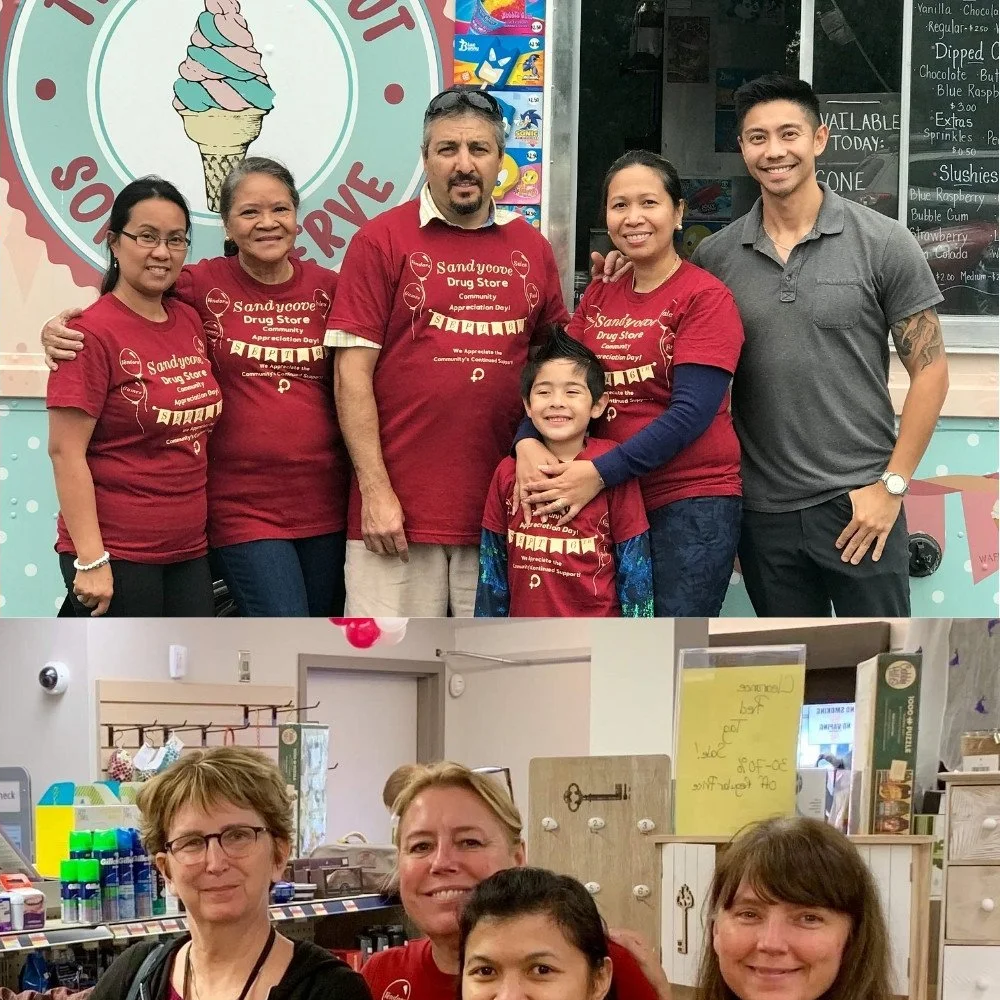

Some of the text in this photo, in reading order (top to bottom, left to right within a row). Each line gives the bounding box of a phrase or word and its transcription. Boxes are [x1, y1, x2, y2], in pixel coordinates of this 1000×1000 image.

[918, 3, 952, 14] Vanilla
[935, 40, 984, 69] Dipped
[920, 64, 967, 80] Chocolate
[937, 84, 962, 96] Blue
[820, 112, 900, 132] VAILABLE
[936, 112, 973, 128] Extras
[924, 128, 972, 144] Sprinkles
[831, 135, 885, 151] TODAY:
[940, 164, 999, 183] Slushies
[910, 187, 985, 212] Blue Raspberry
[911, 208, 969, 222] Bubble Gum
[437, 259, 513, 276] Sandycove
[447, 277, 508, 290] Drug Store
[459, 293, 497, 301] Community
[233, 300, 315, 313] Sandycove
[448, 304, 510, 312] Appreciation Day!
[244, 315, 310, 326] Drug Store
[262, 326, 304, 334] Community
[596, 331, 617, 340] Drug
[252, 334, 301, 343] Appreciation
[627, 354, 642, 362] Day!
[161, 369, 208, 385] Drug Store
[562, 526, 579, 536] Day!
